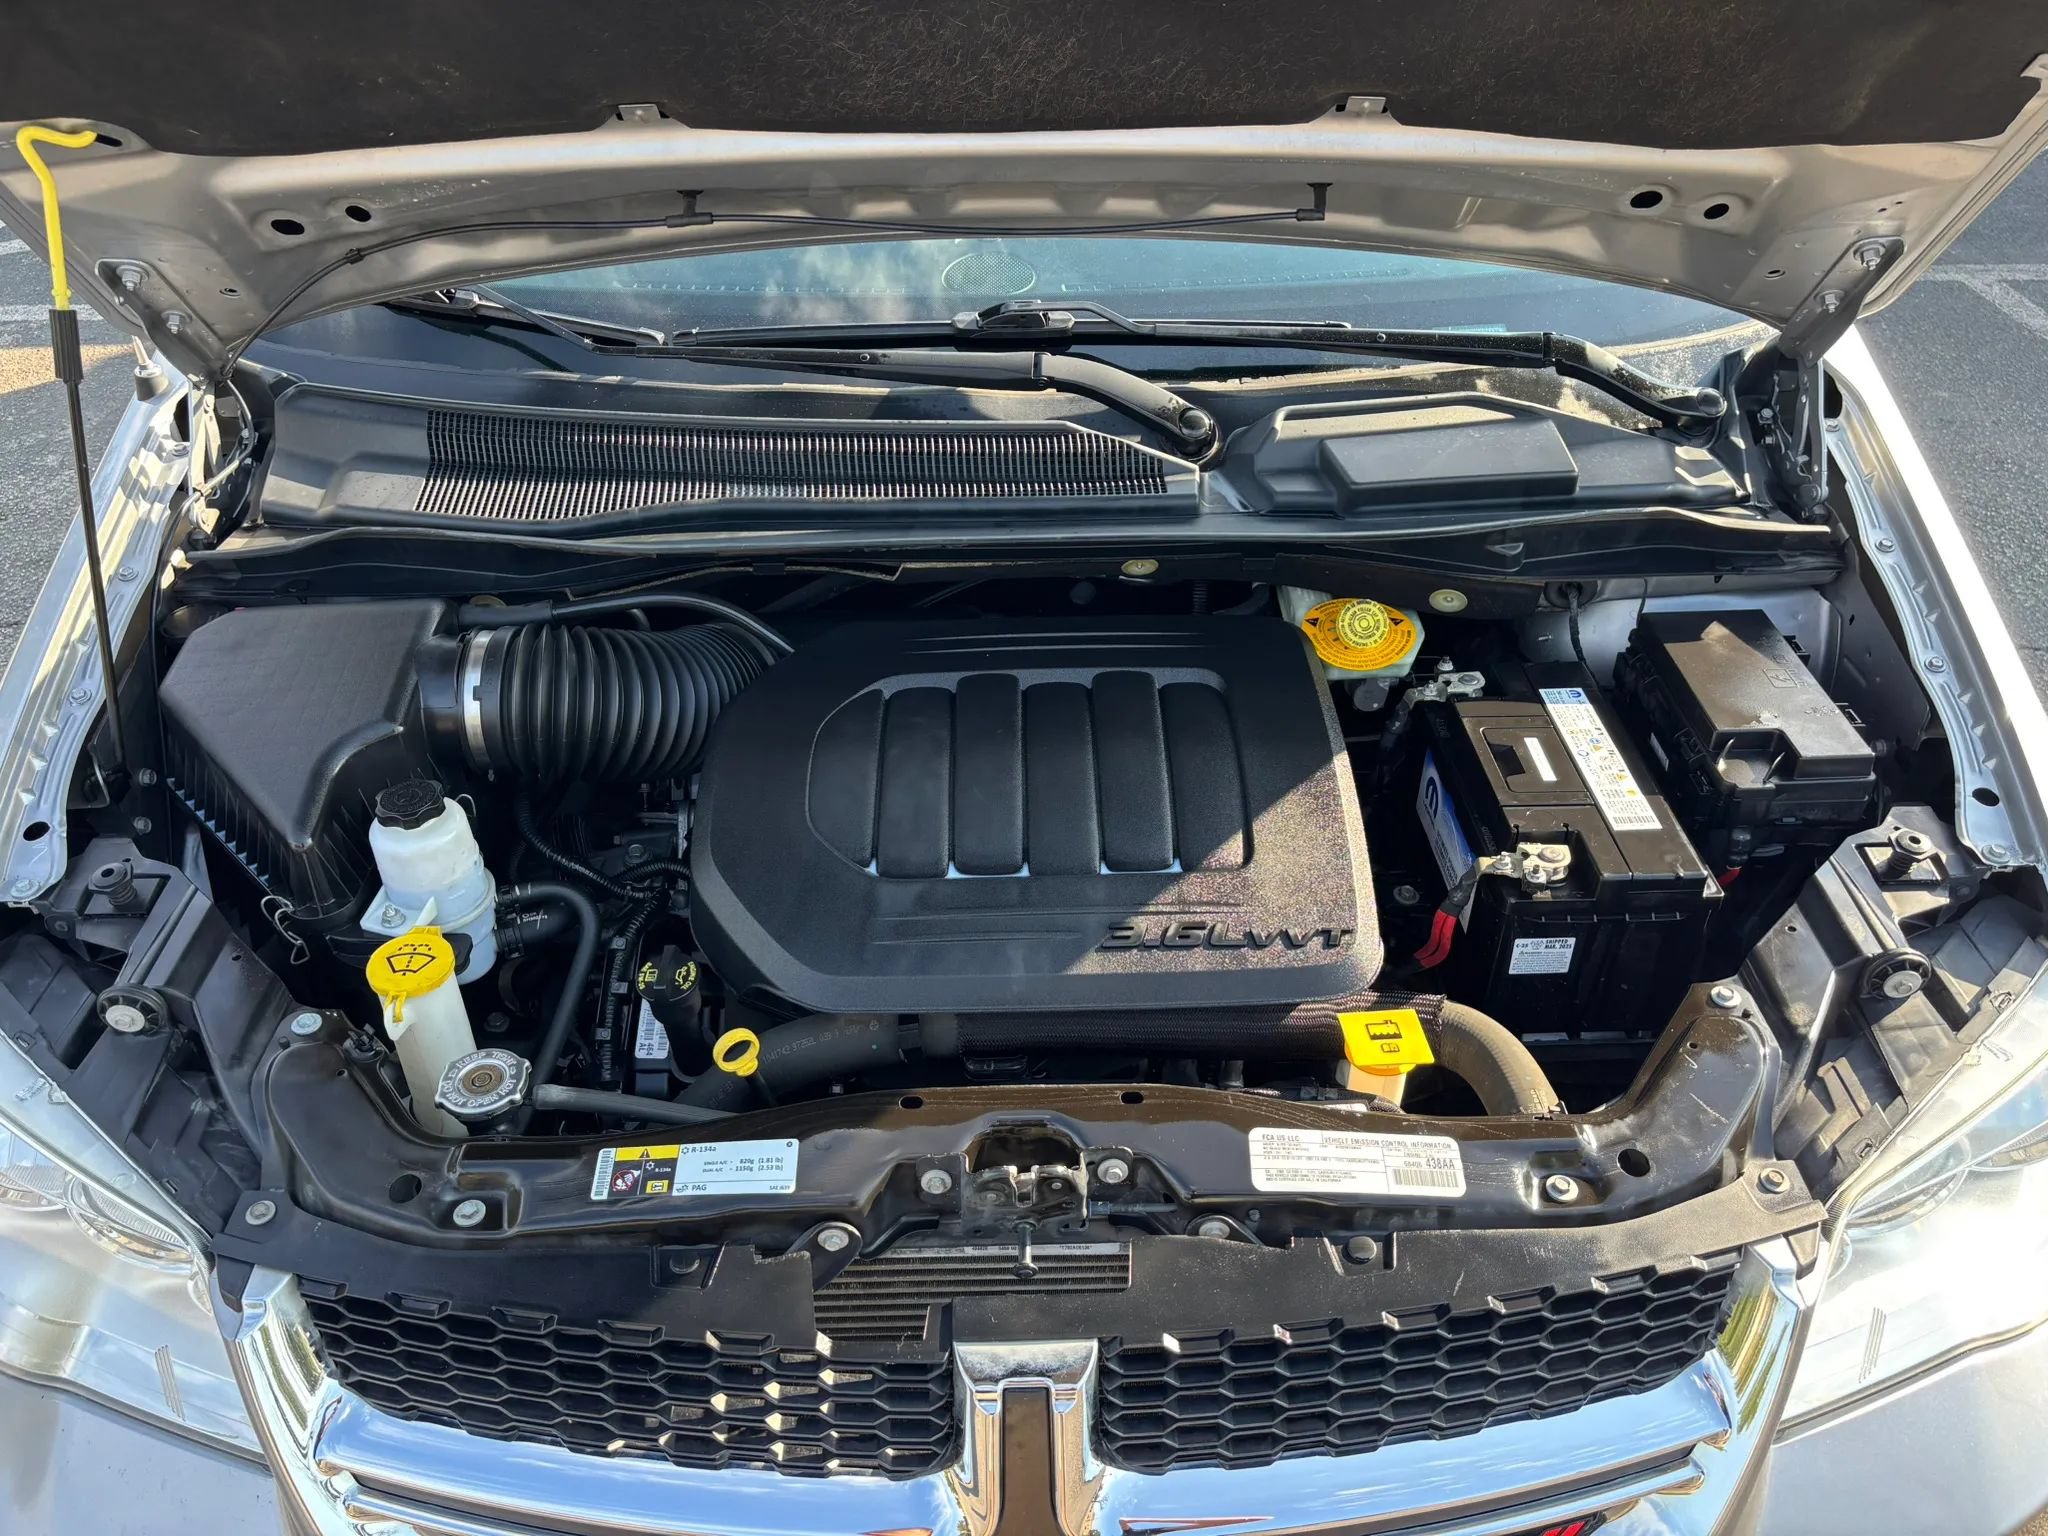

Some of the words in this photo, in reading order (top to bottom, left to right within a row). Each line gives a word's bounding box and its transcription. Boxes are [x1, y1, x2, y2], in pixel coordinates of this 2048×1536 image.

[680, 980, 692, 990] OIL
[456, 1052, 487, 1068] KEEP
[492, 1050, 517, 1068] TIGHT
[446, 1092, 466, 1106] NOT
[466, 1093, 499, 1108] OPEN
[498, 1079, 517, 1096] HOT
[1324, 1137, 1349, 1145] VEHICLE
[1350, 1138, 1380, 1146] EMISSION
[1381, 1140, 1408, 1148] CONTROL
[1410, 1141, 1452, 1150] INFORMATION
[1426, 1158, 1456, 1170] 438AA
